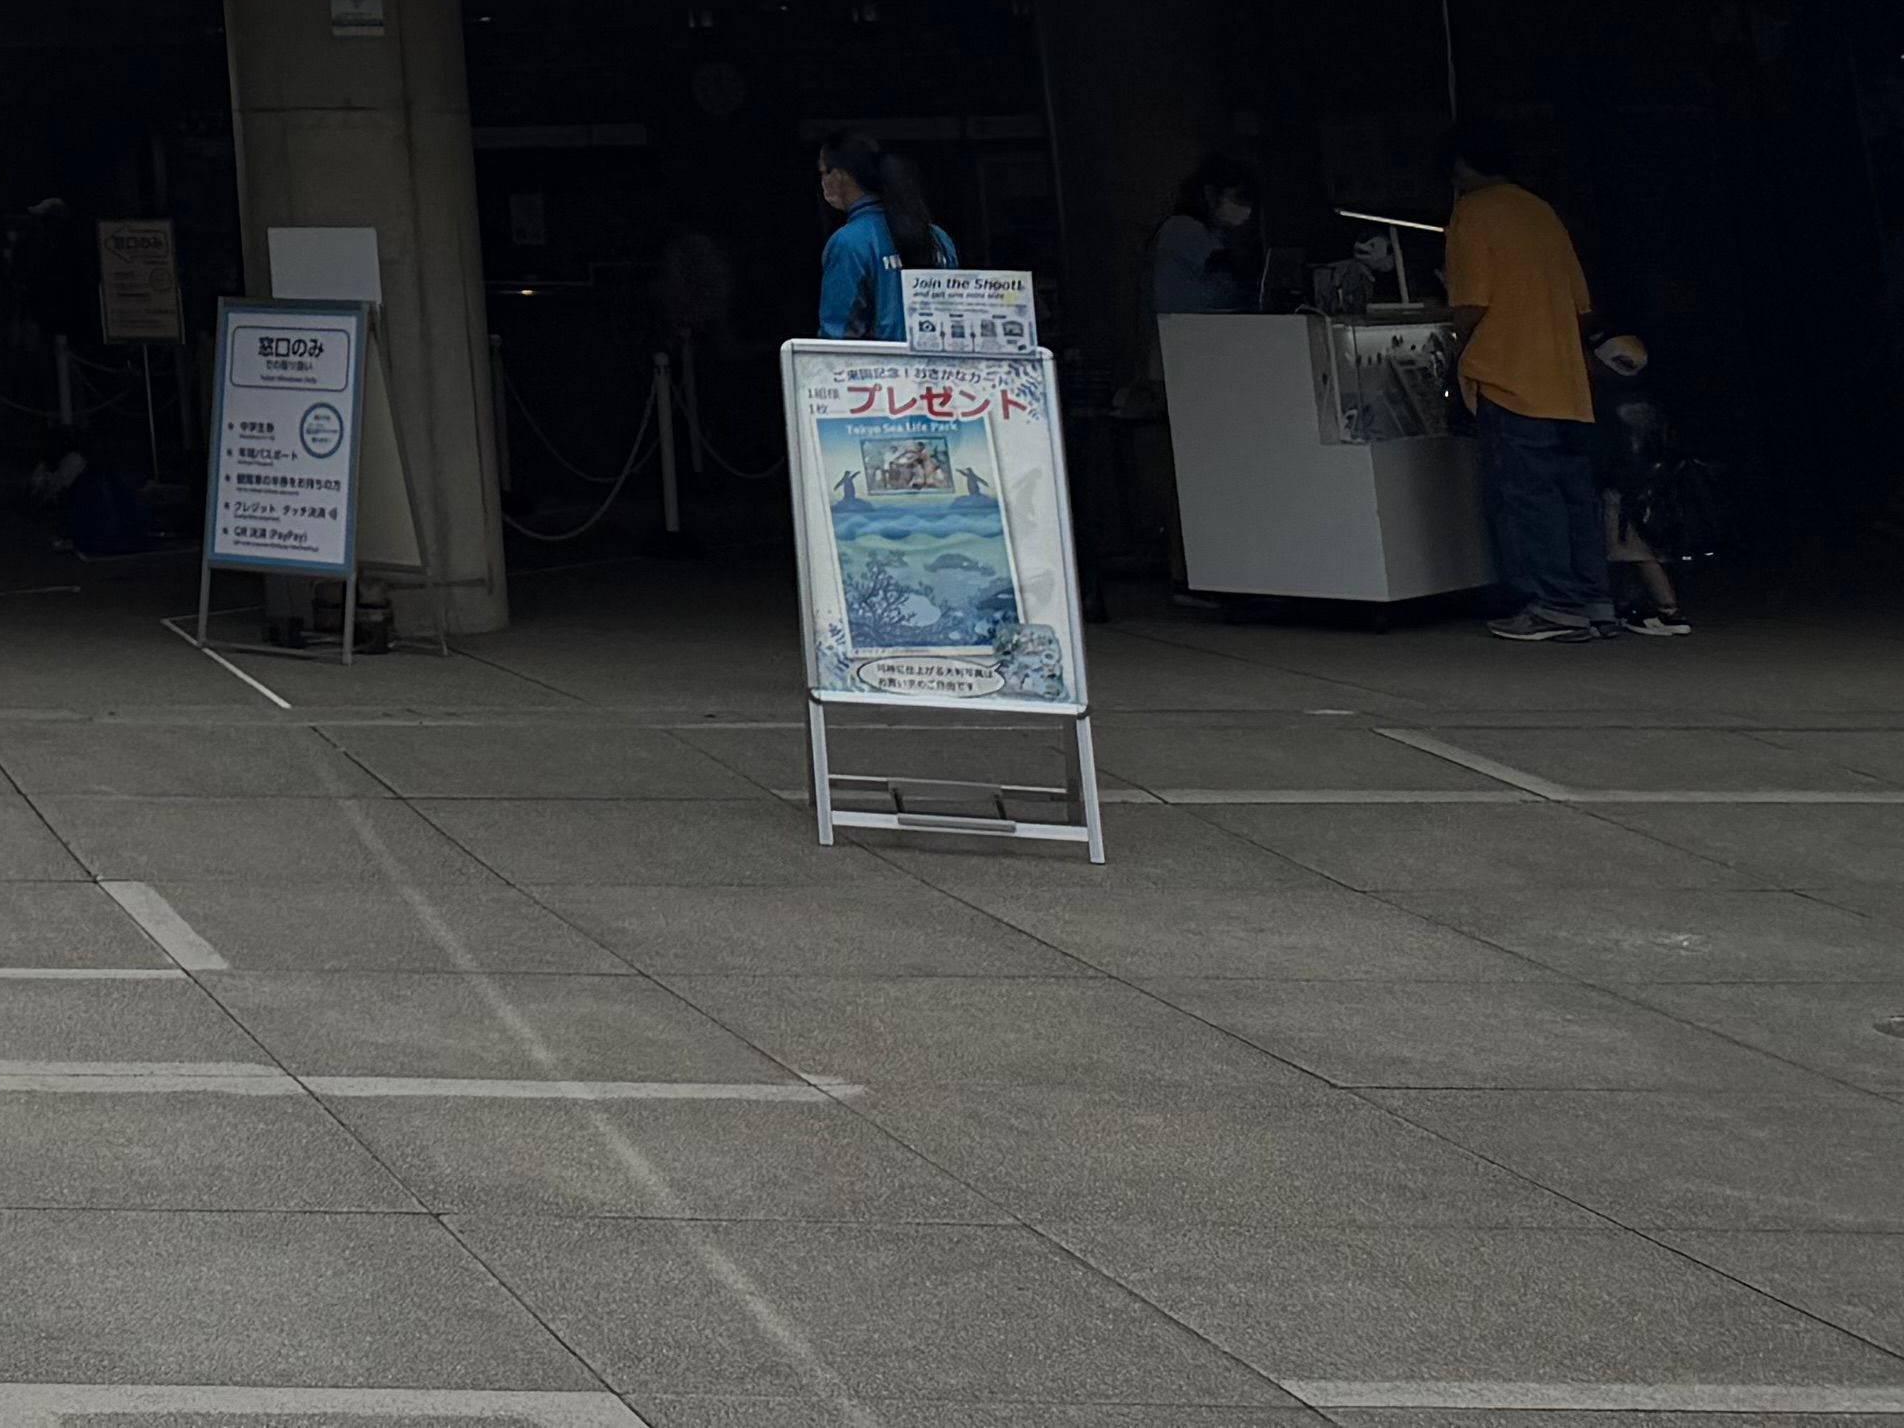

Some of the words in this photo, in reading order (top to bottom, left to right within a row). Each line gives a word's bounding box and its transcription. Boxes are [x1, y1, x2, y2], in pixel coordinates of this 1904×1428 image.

[912, 277, 941, 289] Join
[946, 278, 970, 289] the
[257, 336, 325, 358] 窓口のみ
[847, 383, 1028, 421] プレゼント
[883, 423, 904, 433] Sea
[905, 421, 928, 432] Life
[233, 501, 276, 514] クレジット
